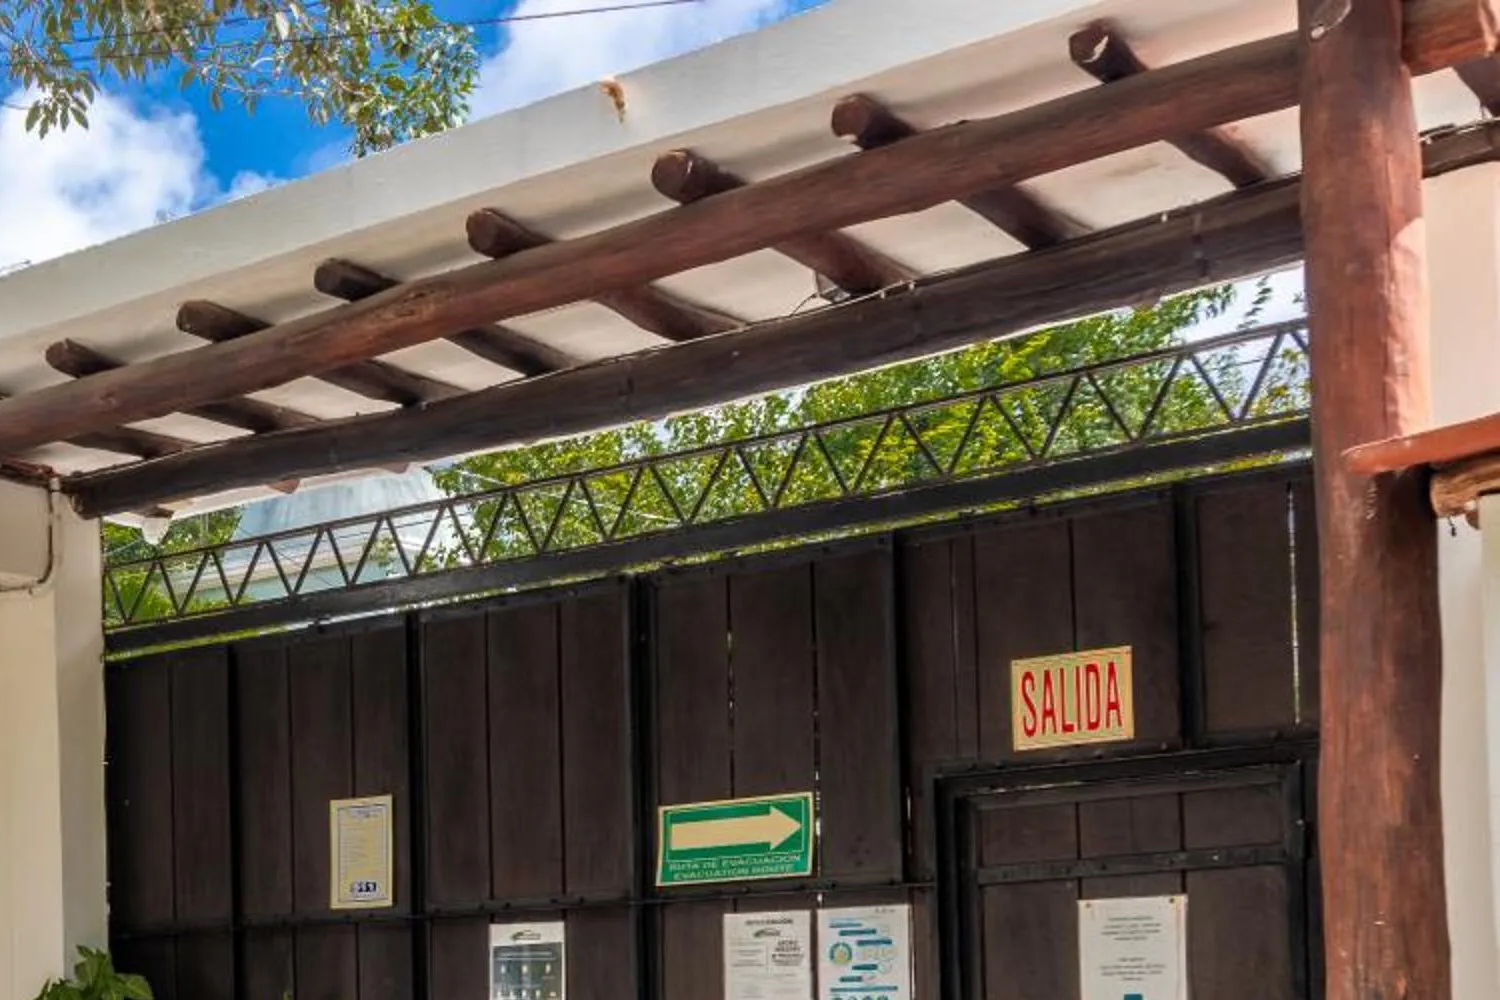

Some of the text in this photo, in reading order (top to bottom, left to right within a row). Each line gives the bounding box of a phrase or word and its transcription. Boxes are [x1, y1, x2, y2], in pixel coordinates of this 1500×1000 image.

[1020, 660, 1123, 738] SALIDA
[669, 861, 700, 872] RUTA
[703, 860, 718, 869] DE
[673, 863, 794, 880] EVACUATION ROUTE
